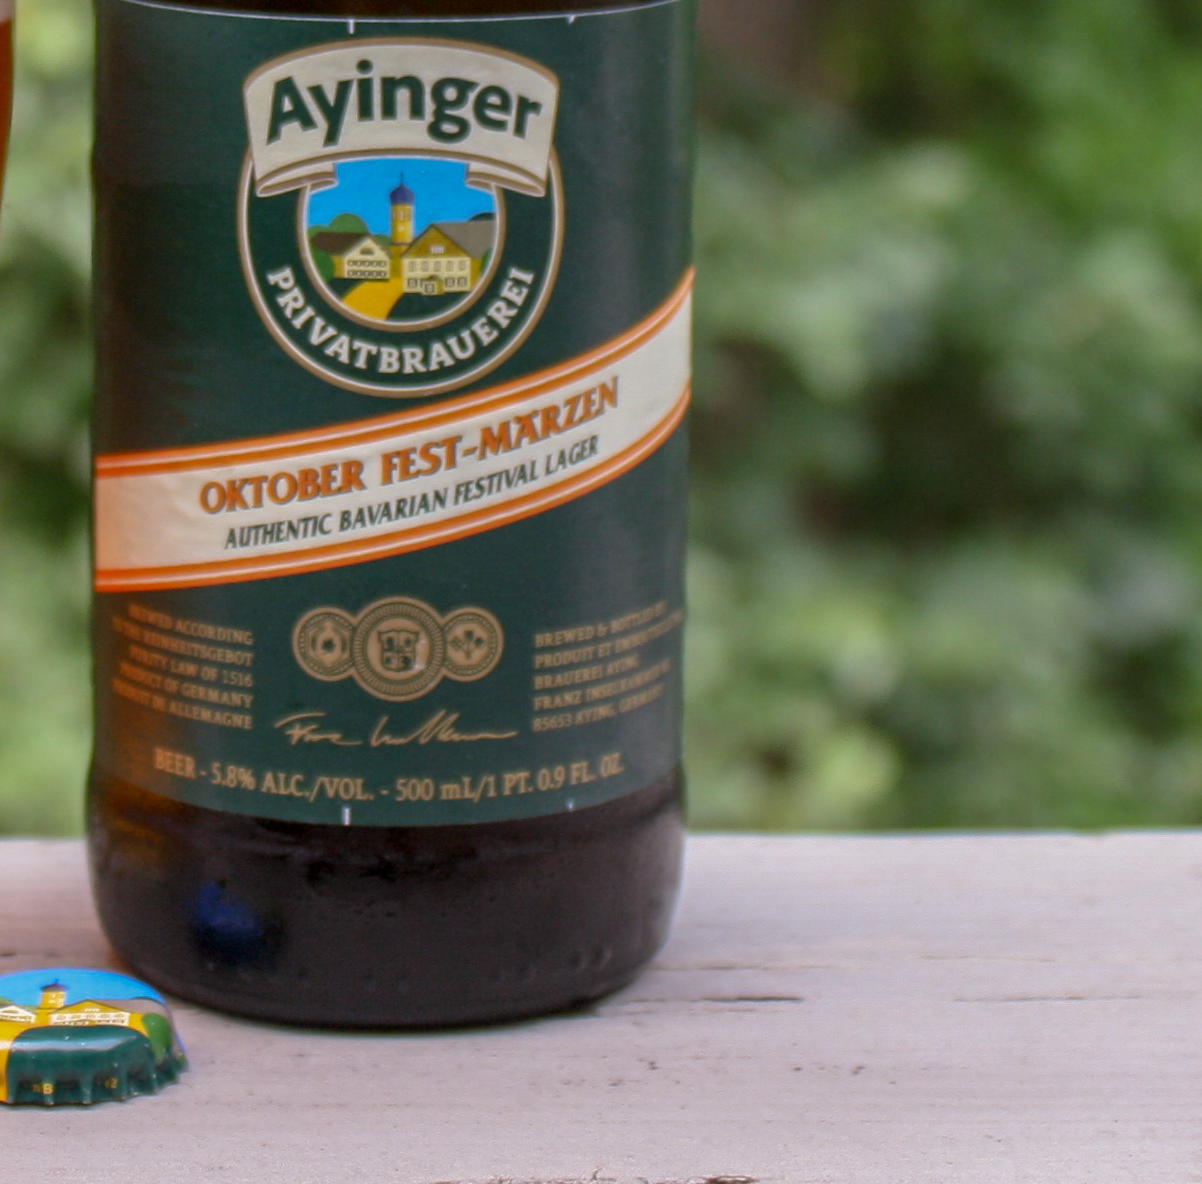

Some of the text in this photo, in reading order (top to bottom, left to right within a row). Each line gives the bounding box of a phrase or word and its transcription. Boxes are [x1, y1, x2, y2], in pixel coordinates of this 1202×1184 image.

[266, 59, 543, 147] Ayinger
[266, 267, 535, 375] PRIVATBRAUEREI
[200, 458, 368, 515] OKTOBER
[225, 434, 599, 551] AUTHENTIC BAVARIAN FESTIVAL LAGER
[175, 618, 254, 646] ACCORDING
[534, 625, 596, 648] BREWED
[534, 646, 596, 670] PRODUIT
[221, 669, 254, 688] 1516
[533, 665, 604, 691] BRAUEREI
[180, 682, 254, 709] GERMANY
[533, 690, 583, 712] FRANZ
[533, 714, 573, 733] 85653
[154, 747, 196, 779] BEER
[211, 762, 257, 790] 5.8%
[261, 772, 375, 803] ALC./VOL.
[395, 778, 435, 802] 500
[502, 771, 534, 797] PT.
[537, 765, 566, 792] 0.9
[569, 760, 596, 786] FL.
